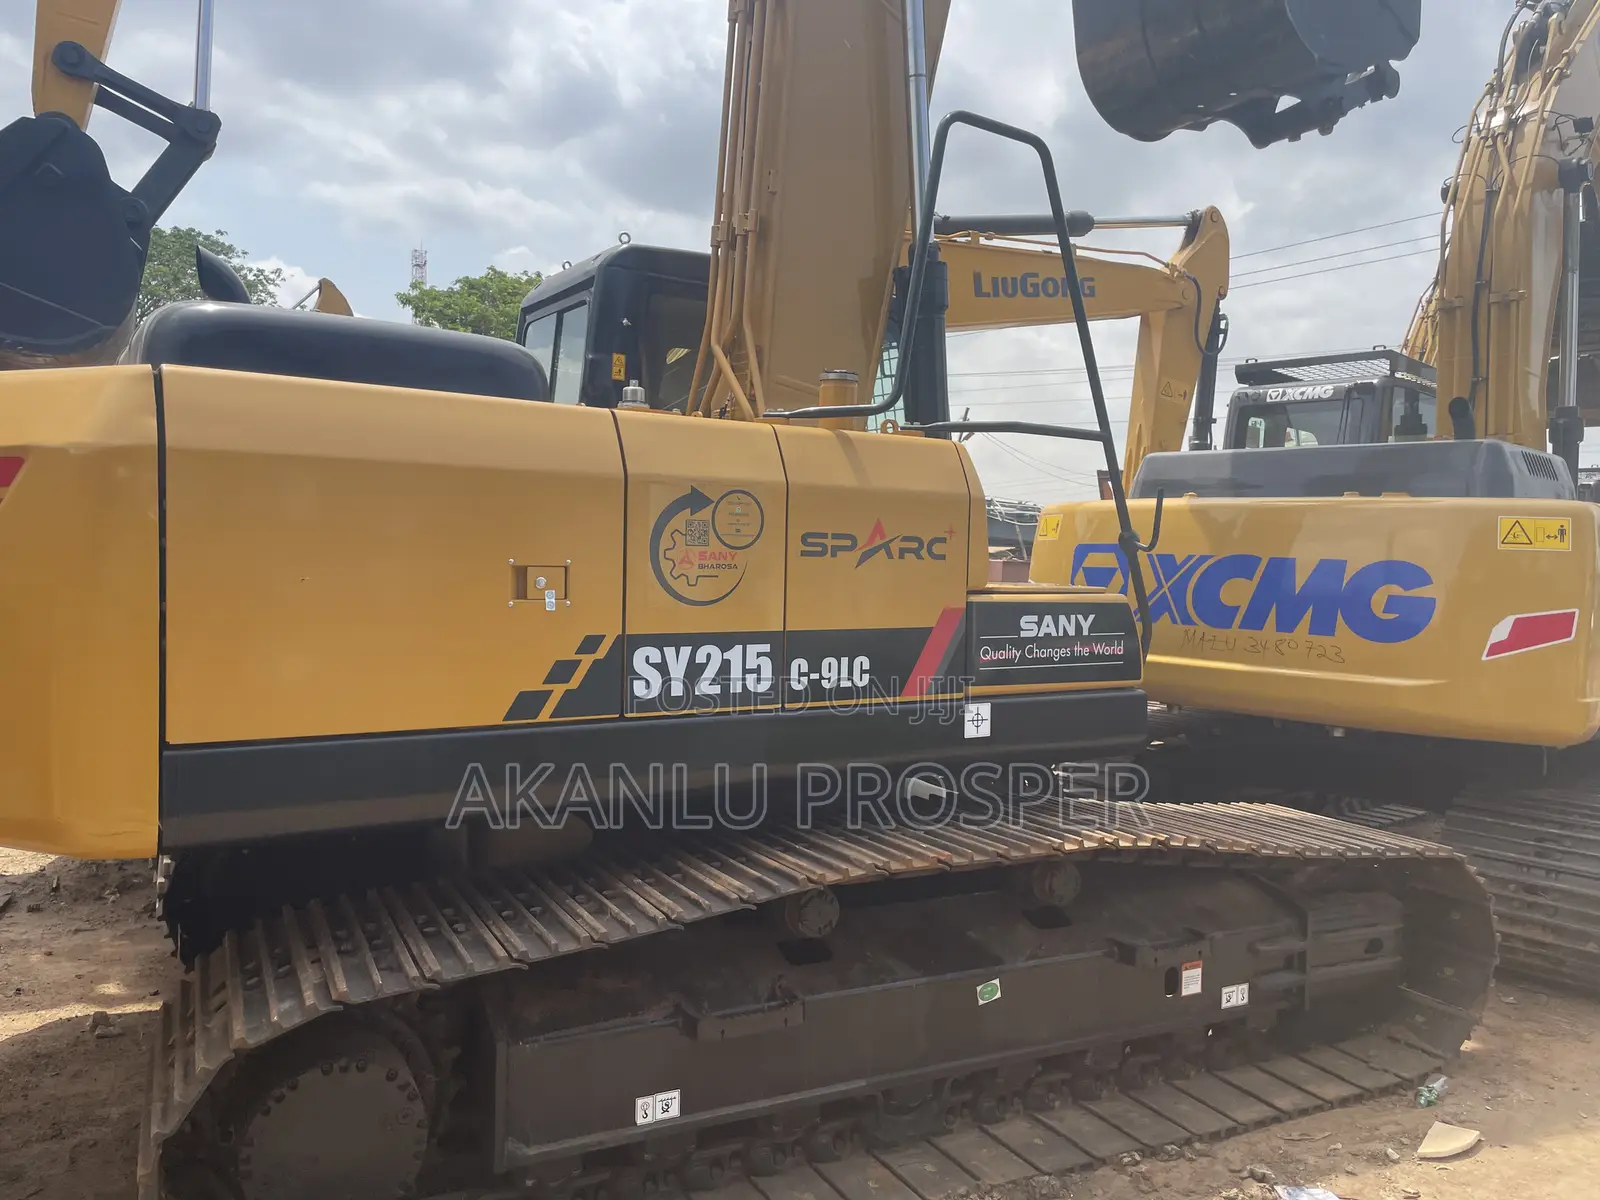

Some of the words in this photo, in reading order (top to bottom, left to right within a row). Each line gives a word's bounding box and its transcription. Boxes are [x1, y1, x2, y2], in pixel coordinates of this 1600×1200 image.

[1282, 385, 1335, 401] XCMG
[697, 551, 738, 562] SANY
[1133, 553, 1437, 643] XCMG
[1019, 613, 1096, 638] SANY
[979, 645, 1022, 664] Quality
[1025, 644, 1071, 662] Changes
[1074, 643, 1090, 657] the
[1092, 640, 1124, 656] World
[632, 643, 773, 700] SY215
[789, 655, 871, 692] C-9LC
